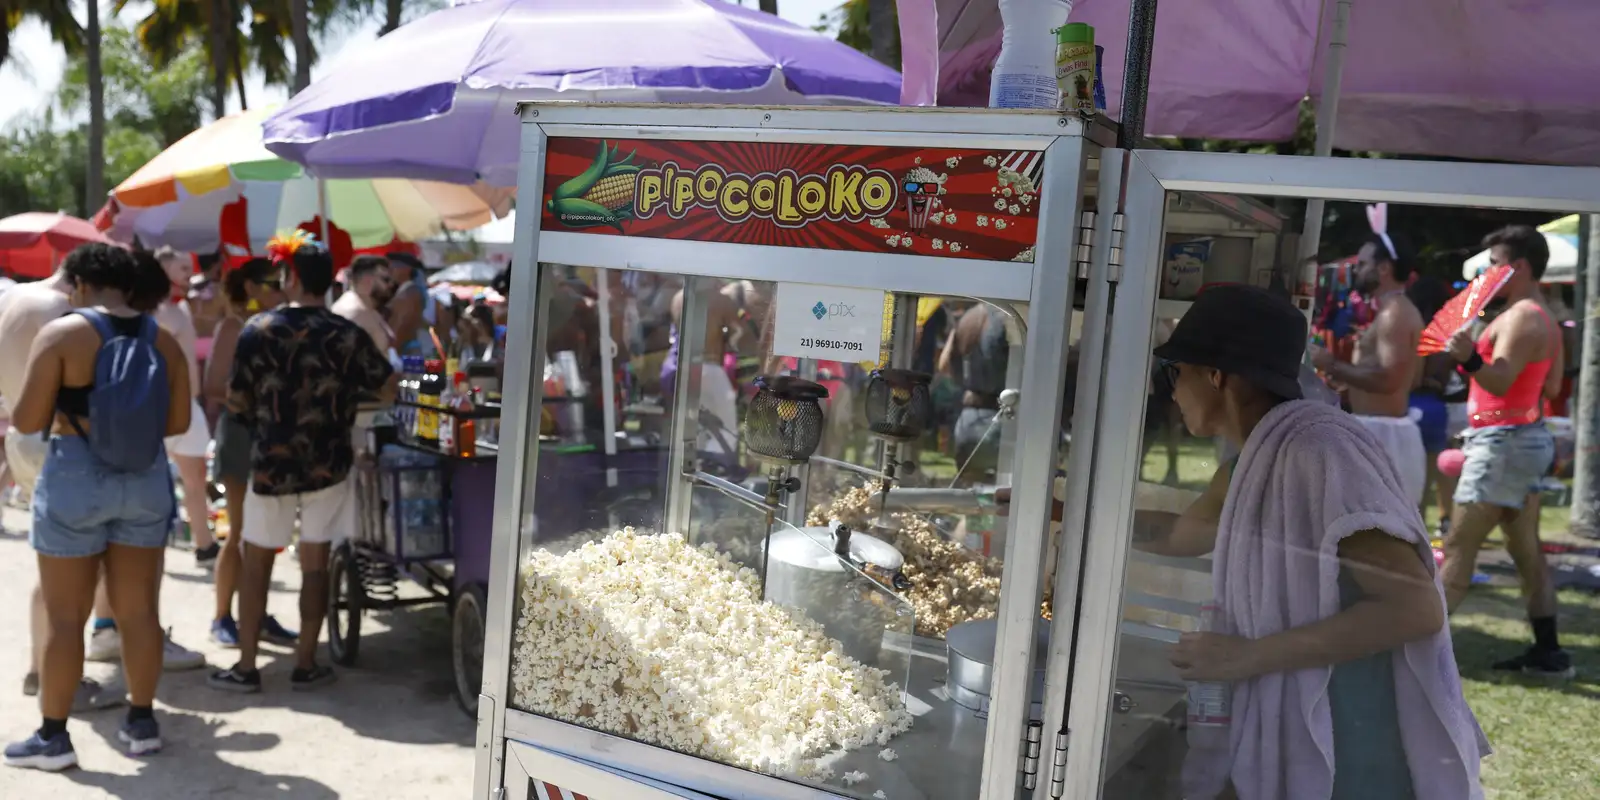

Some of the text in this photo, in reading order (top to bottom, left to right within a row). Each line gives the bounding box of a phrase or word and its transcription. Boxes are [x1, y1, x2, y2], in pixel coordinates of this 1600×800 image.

[828, 302, 856, 320] pix
[800, 338, 863, 351] 21) 96910-7091
